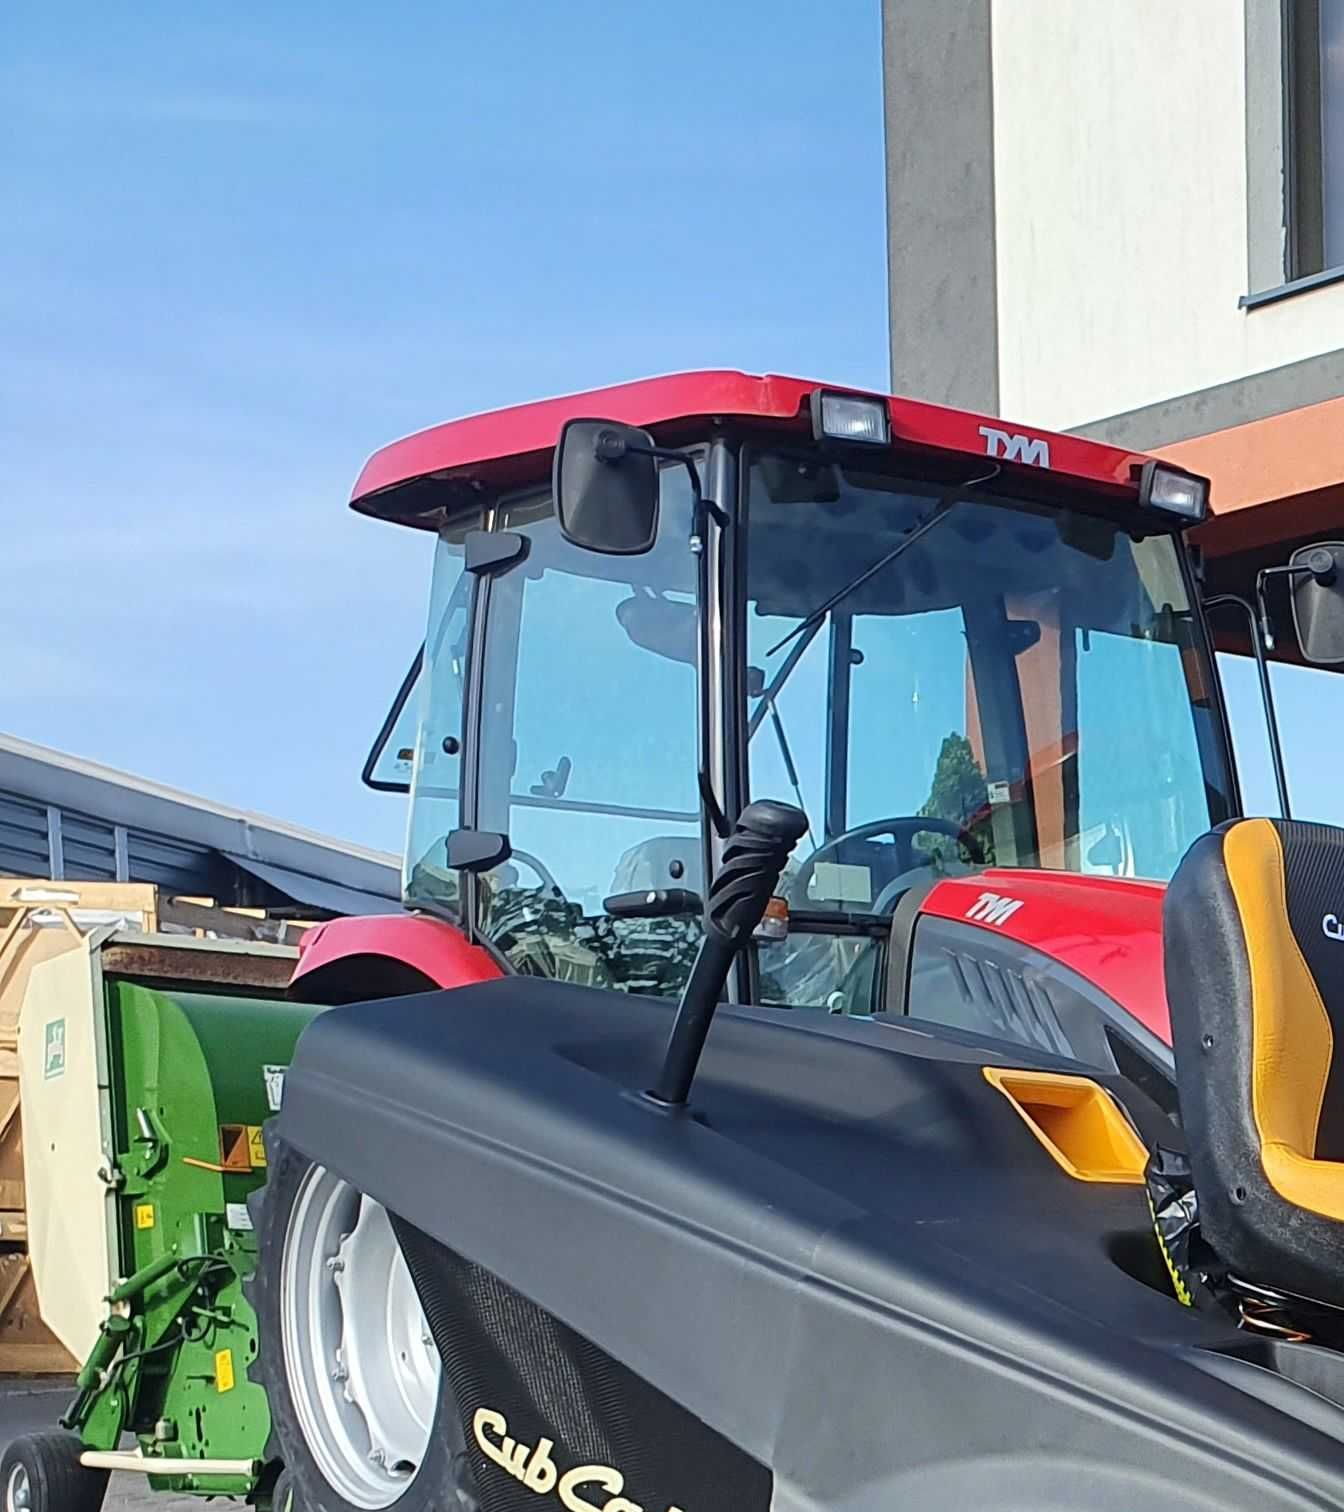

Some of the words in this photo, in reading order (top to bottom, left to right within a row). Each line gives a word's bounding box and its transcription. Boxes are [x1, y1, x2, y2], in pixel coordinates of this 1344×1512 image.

[978, 426, 1050, 469] TYM
[964, 891, 1025, 927] TYM
[473, 1407, 558, 1495] Cub
